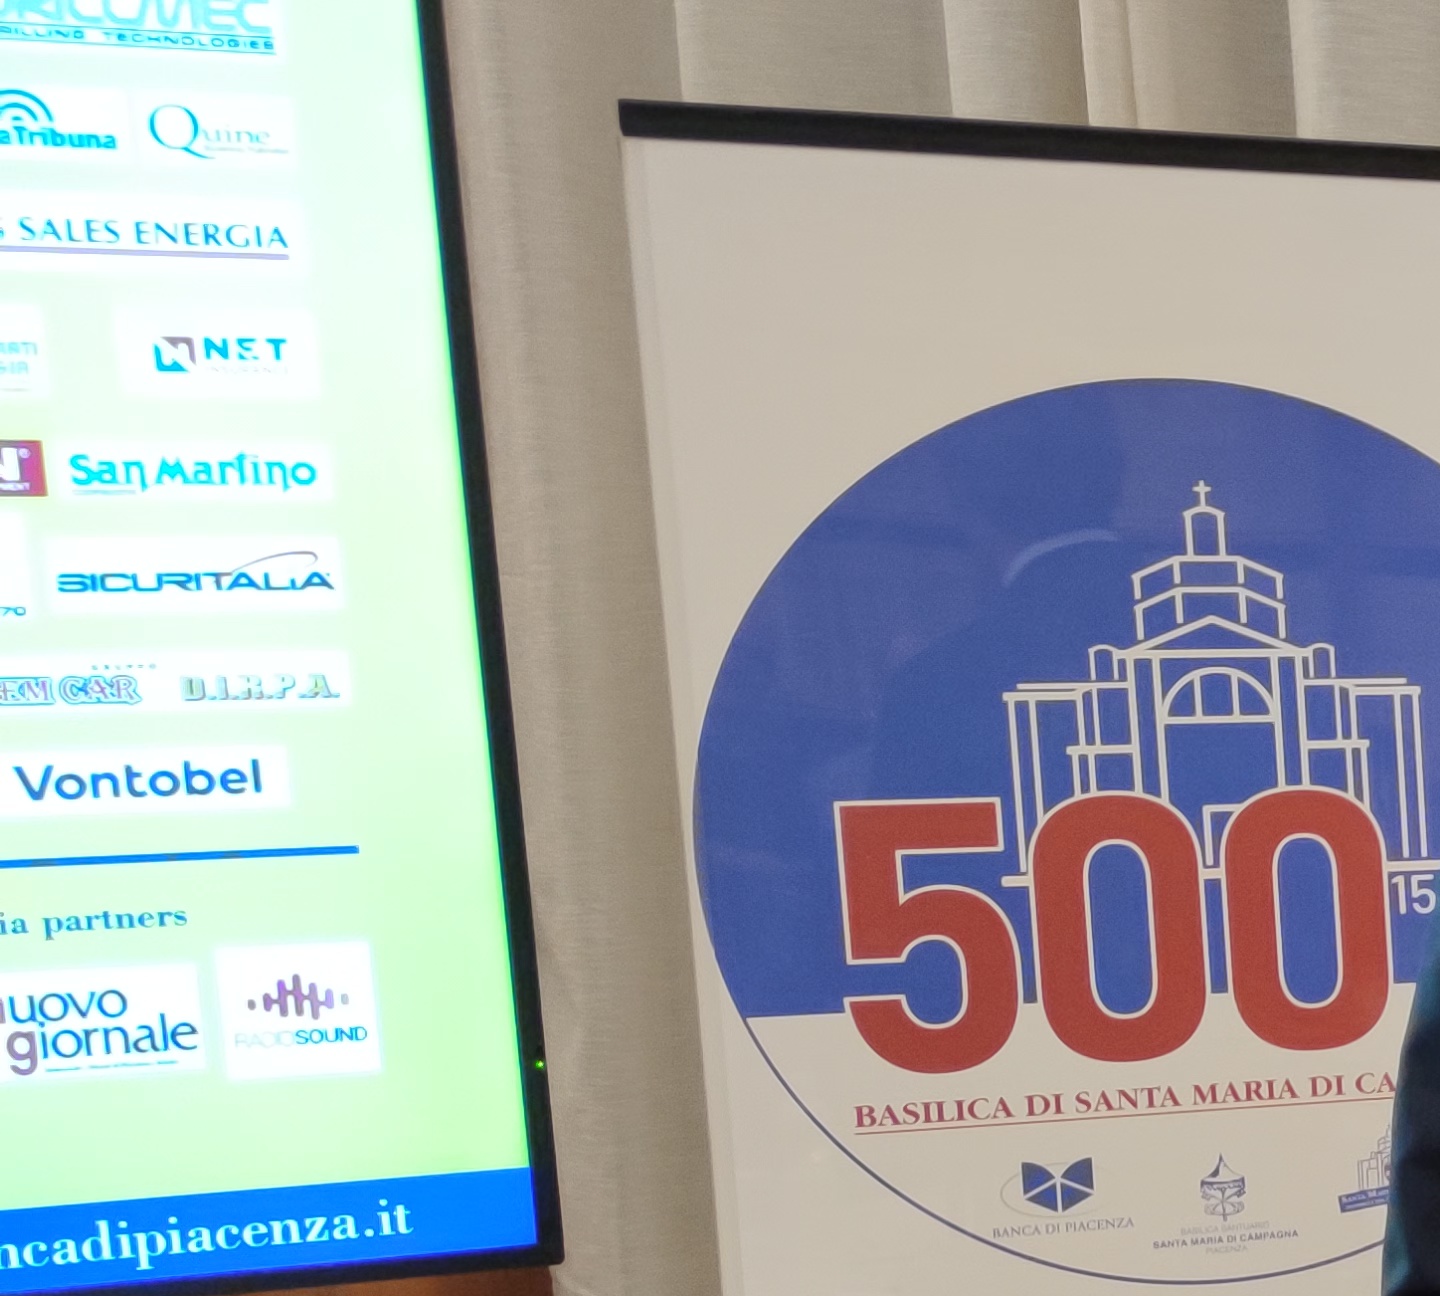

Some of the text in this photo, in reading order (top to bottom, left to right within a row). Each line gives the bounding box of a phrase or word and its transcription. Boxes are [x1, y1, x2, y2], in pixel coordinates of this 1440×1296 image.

[18, 216, 121, 244] SALES
[135, 220, 289, 249] ENERGIA
[203, 337, 287, 361] NET
[13, 758, 263, 801] Vontobel
[42, 908, 189, 942] partners
[834, 785, 1394, 1076] 500
[6, 1012, 199, 1076] giornale
[854, 1094, 1012, 1129] BASILICA
[1025, 1093, 1064, 1118] DI
[1075, 1086, 1183, 1114] SANTA
[1192, 1077, 1300, 1107] MARIA
[1309, 1073, 1346, 1098] DI
[992, 1223, 1042, 1240] BANCA
[1065, 1217, 1135, 1234] PIACENZA
[1152, 1238, 1190, 1250] SANTA
[1190, 1235, 1224, 1247] MARIA
[1239, 1229, 1300, 1244] CAMPAGNA
